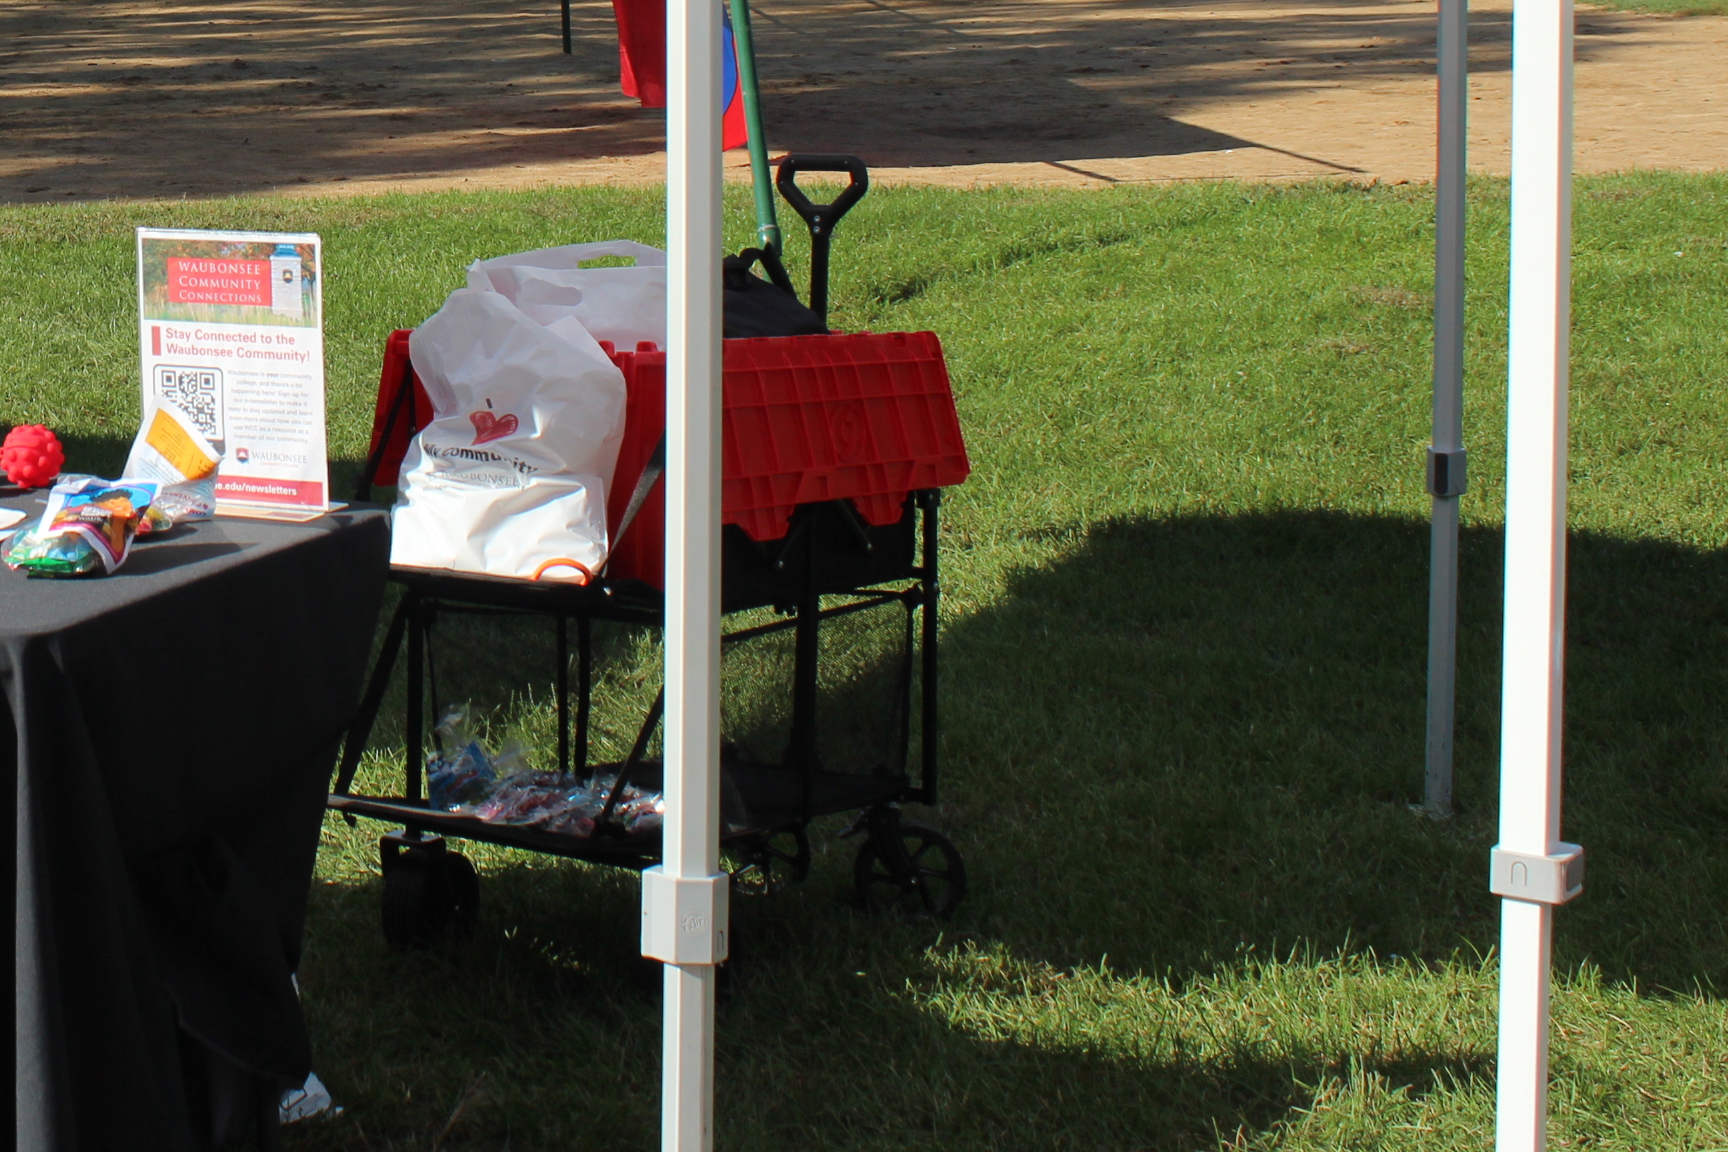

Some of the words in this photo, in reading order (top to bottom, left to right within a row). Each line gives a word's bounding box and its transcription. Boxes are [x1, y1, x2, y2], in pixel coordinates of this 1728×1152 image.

[178, 261, 261, 275] WAUBONSEE
[179, 276, 261, 290] COMMUNITY
[179, 290, 262, 303] CONNECTIONS
[166, 328, 191, 340] Stay
[195, 329, 257, 343] Connected
[261, 333, 272, 344] to
[276, 334, 295, 345] the
[166, 343, 233, 358] Waubonsee
[236, 347, 310, 363] Community!
[231, 388, 260, 396] happening
[278, 390, 290, 398] Sign
[262, 408, 286, 416] updated
[251, 451, 308, 464] WAUBONSEE
